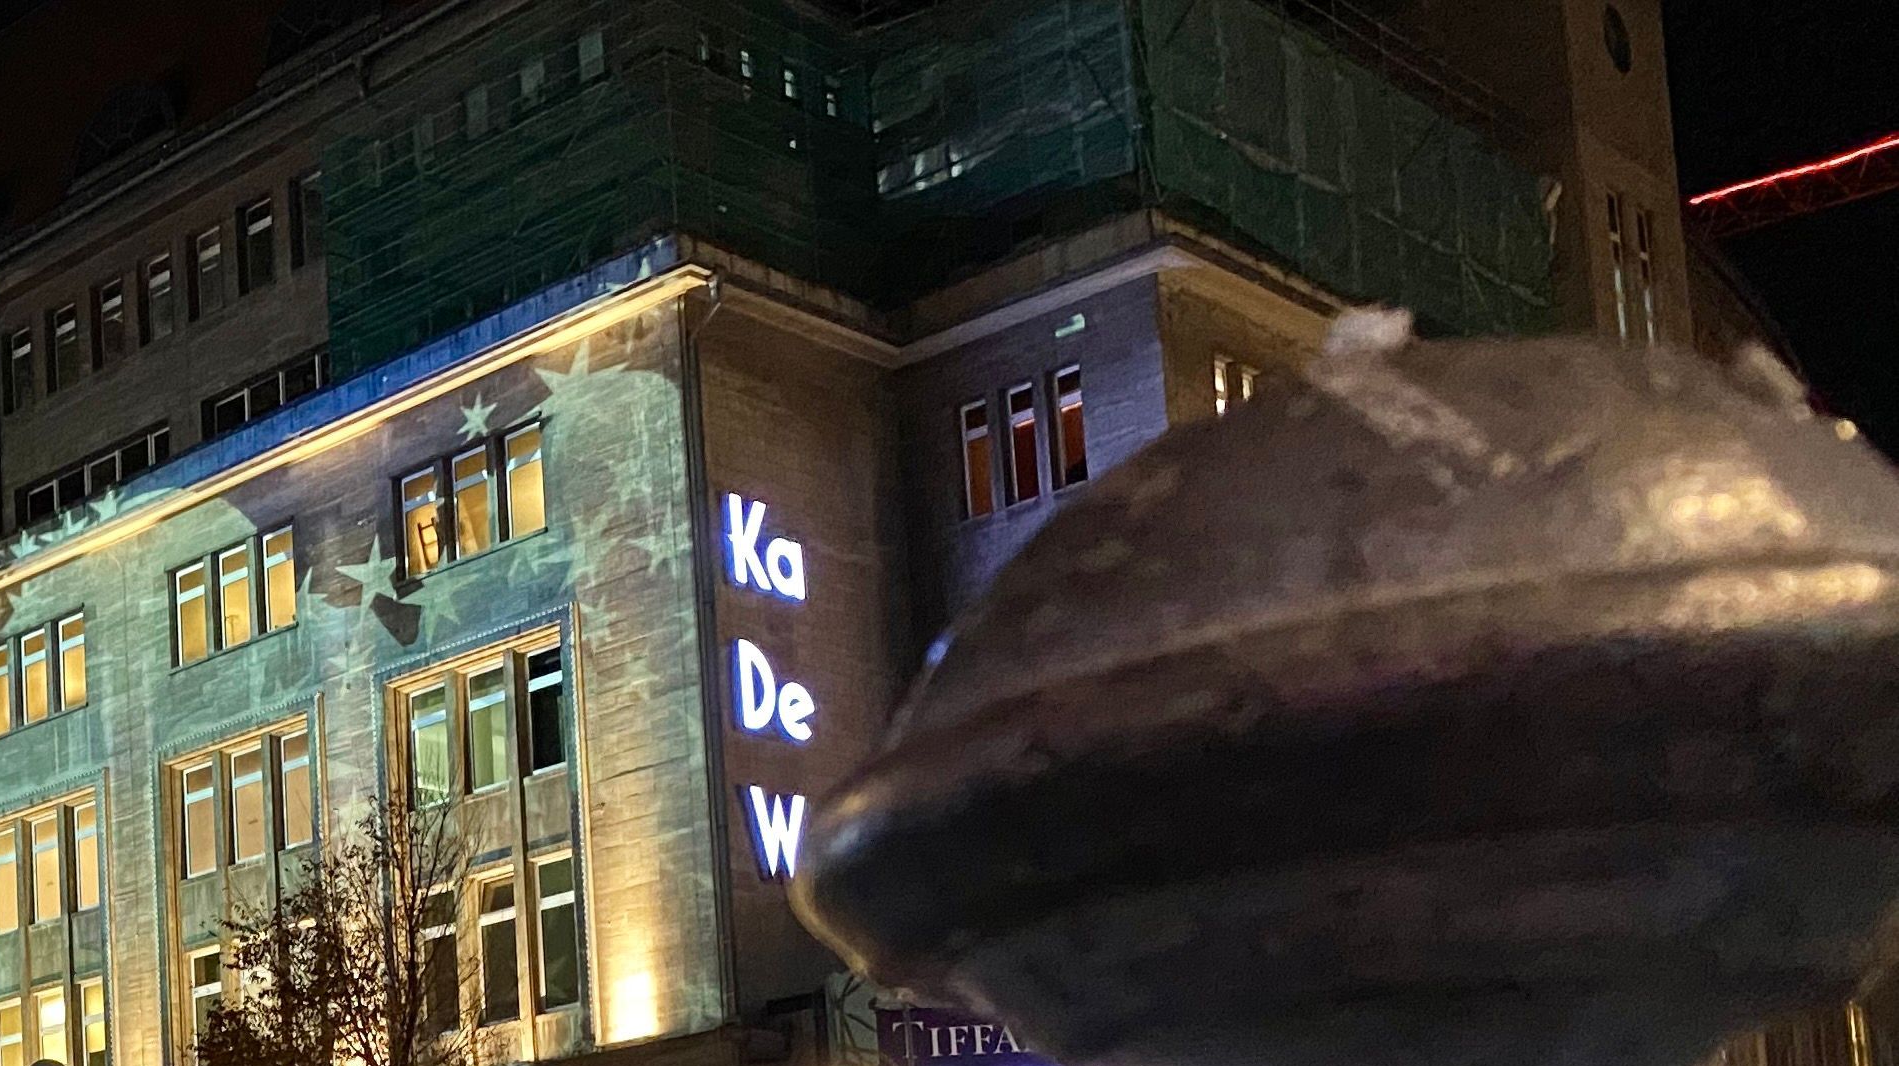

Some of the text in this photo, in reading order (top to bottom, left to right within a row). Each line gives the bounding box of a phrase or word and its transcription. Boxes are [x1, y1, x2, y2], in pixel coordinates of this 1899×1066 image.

[725, 492, 807, 601] Ka
[734, 637, 817, 742] De
[892, 1021, 1032, 1058] TIFFA
